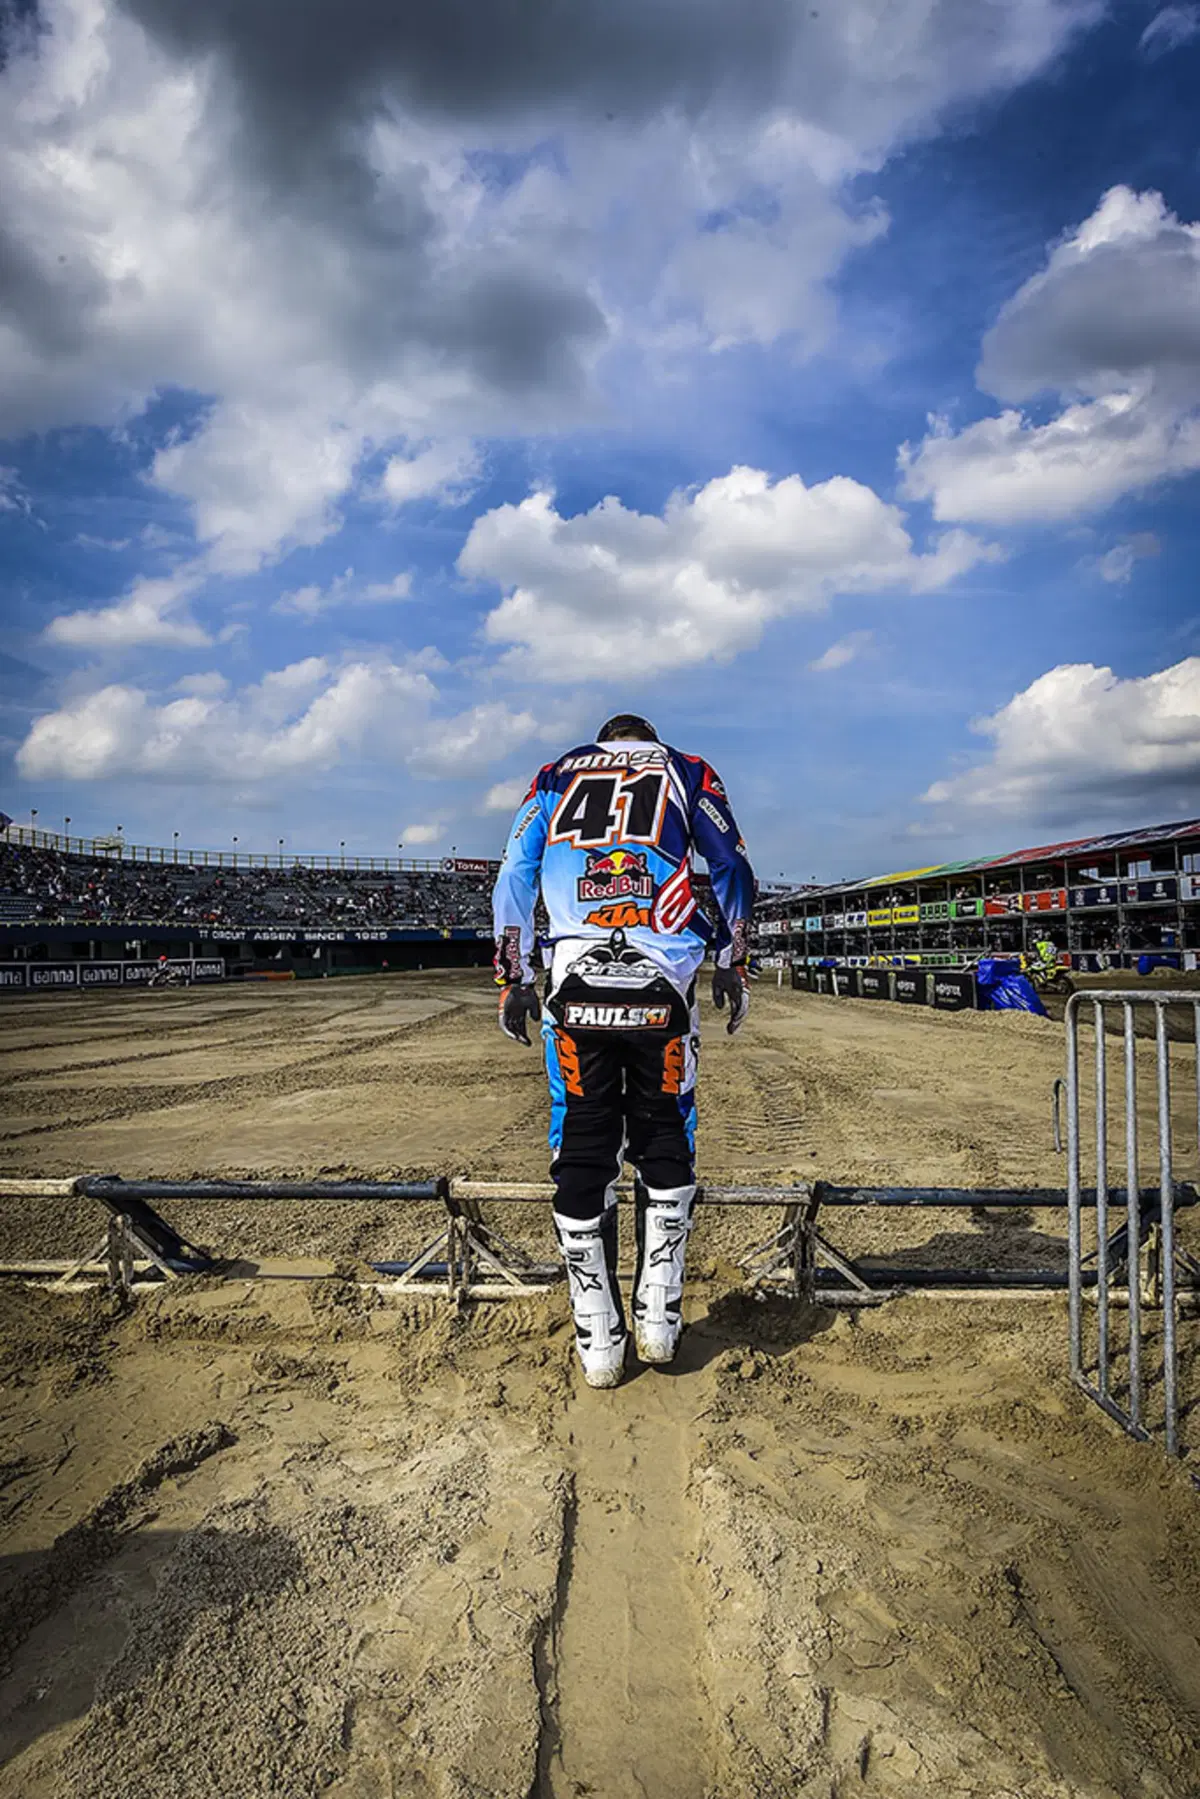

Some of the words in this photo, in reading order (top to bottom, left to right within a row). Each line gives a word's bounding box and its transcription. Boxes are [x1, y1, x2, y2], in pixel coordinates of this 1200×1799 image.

[550, 770, 668, 846] 41
[456, 861, 486, 871] TOTAL
[586, 902, 650, 928] KTM
[212, 930, 246, 940] CIRCUIT
[254, 931, 297, 941] ASSEN
[304, 931, 345, 941] SINCE
[355, 931, 388, 941] 1925
